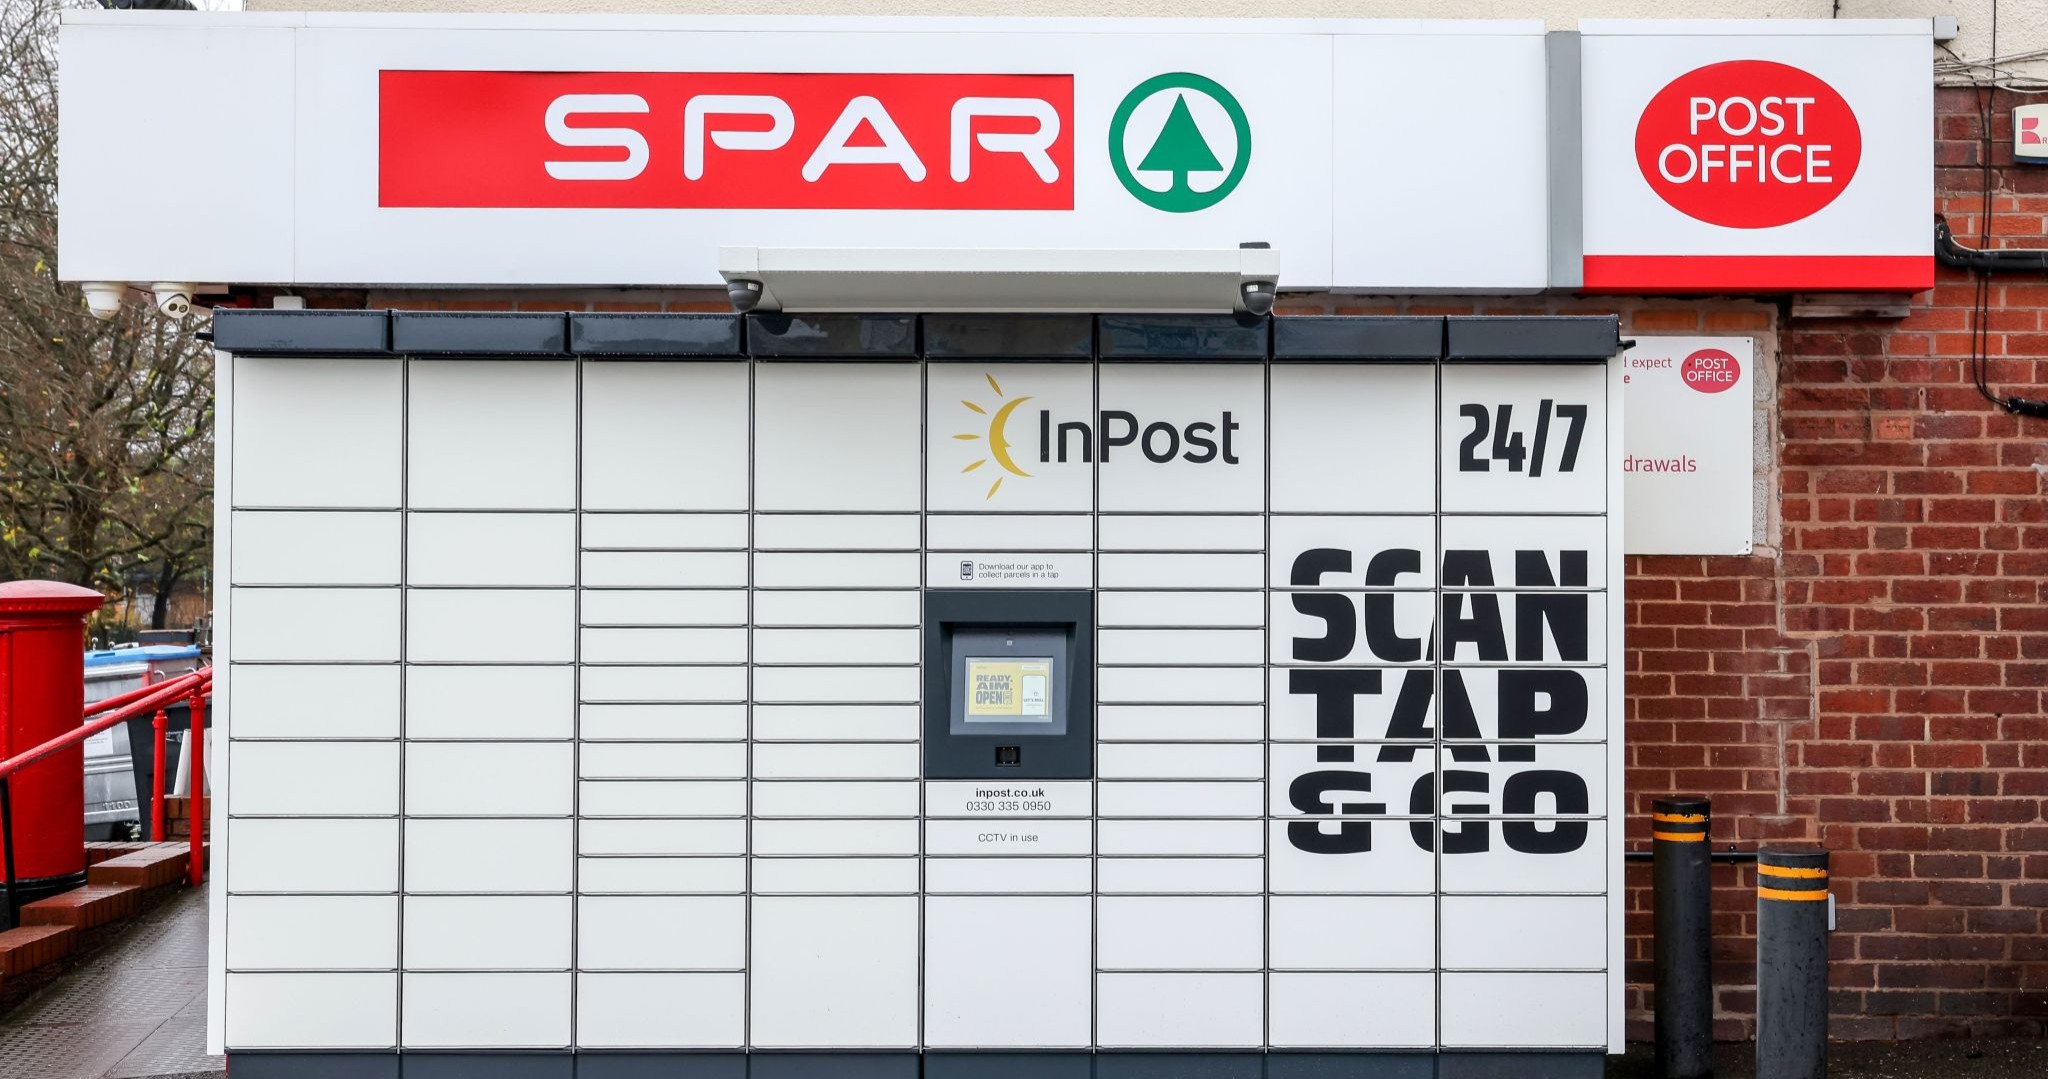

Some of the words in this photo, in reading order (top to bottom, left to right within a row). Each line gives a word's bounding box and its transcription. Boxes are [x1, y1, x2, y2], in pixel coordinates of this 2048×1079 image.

[1689, 96, 1815, 136] POST
[544, 94, 1060, 183] SPAR
[1658, 144, 1833, 184] OFFICE
[1632, 357, 1673, 370] expect
[1686, 371, 1733, 382] OFFICE
[1695, 358, 1728, 369] POST
[1040, 409, 1239, 464] InPost
[1459, 399, 1588, 477] 24/7
[978, 563, 1015, 571] Download
[1030, 564, 1045, 572] app
[1046, 563, 1054, 571] to
[978, 571, 1002, 579] collect
[1003, 571, 1031, 580] parcels
[1032, 571, 1040, 579] in
[1047, 571, 1059, 580] tap
[1290, 548, 1588, 662] SCAN
[1289, 669, 1588, 762] TAP
[966, 801, 995, 811] 0330
[998, 801, 1020, 811] 335
[1022, 801, 1051, 811] 0950
[976, 788, 1045, 799] inpost.co.uk
[1287, 770, 1386, 855] &
[1409, 769, 1588, 855] GO
[978, 833, 1007, 842] CCTV
[1010, 833, 1018, 842] in
